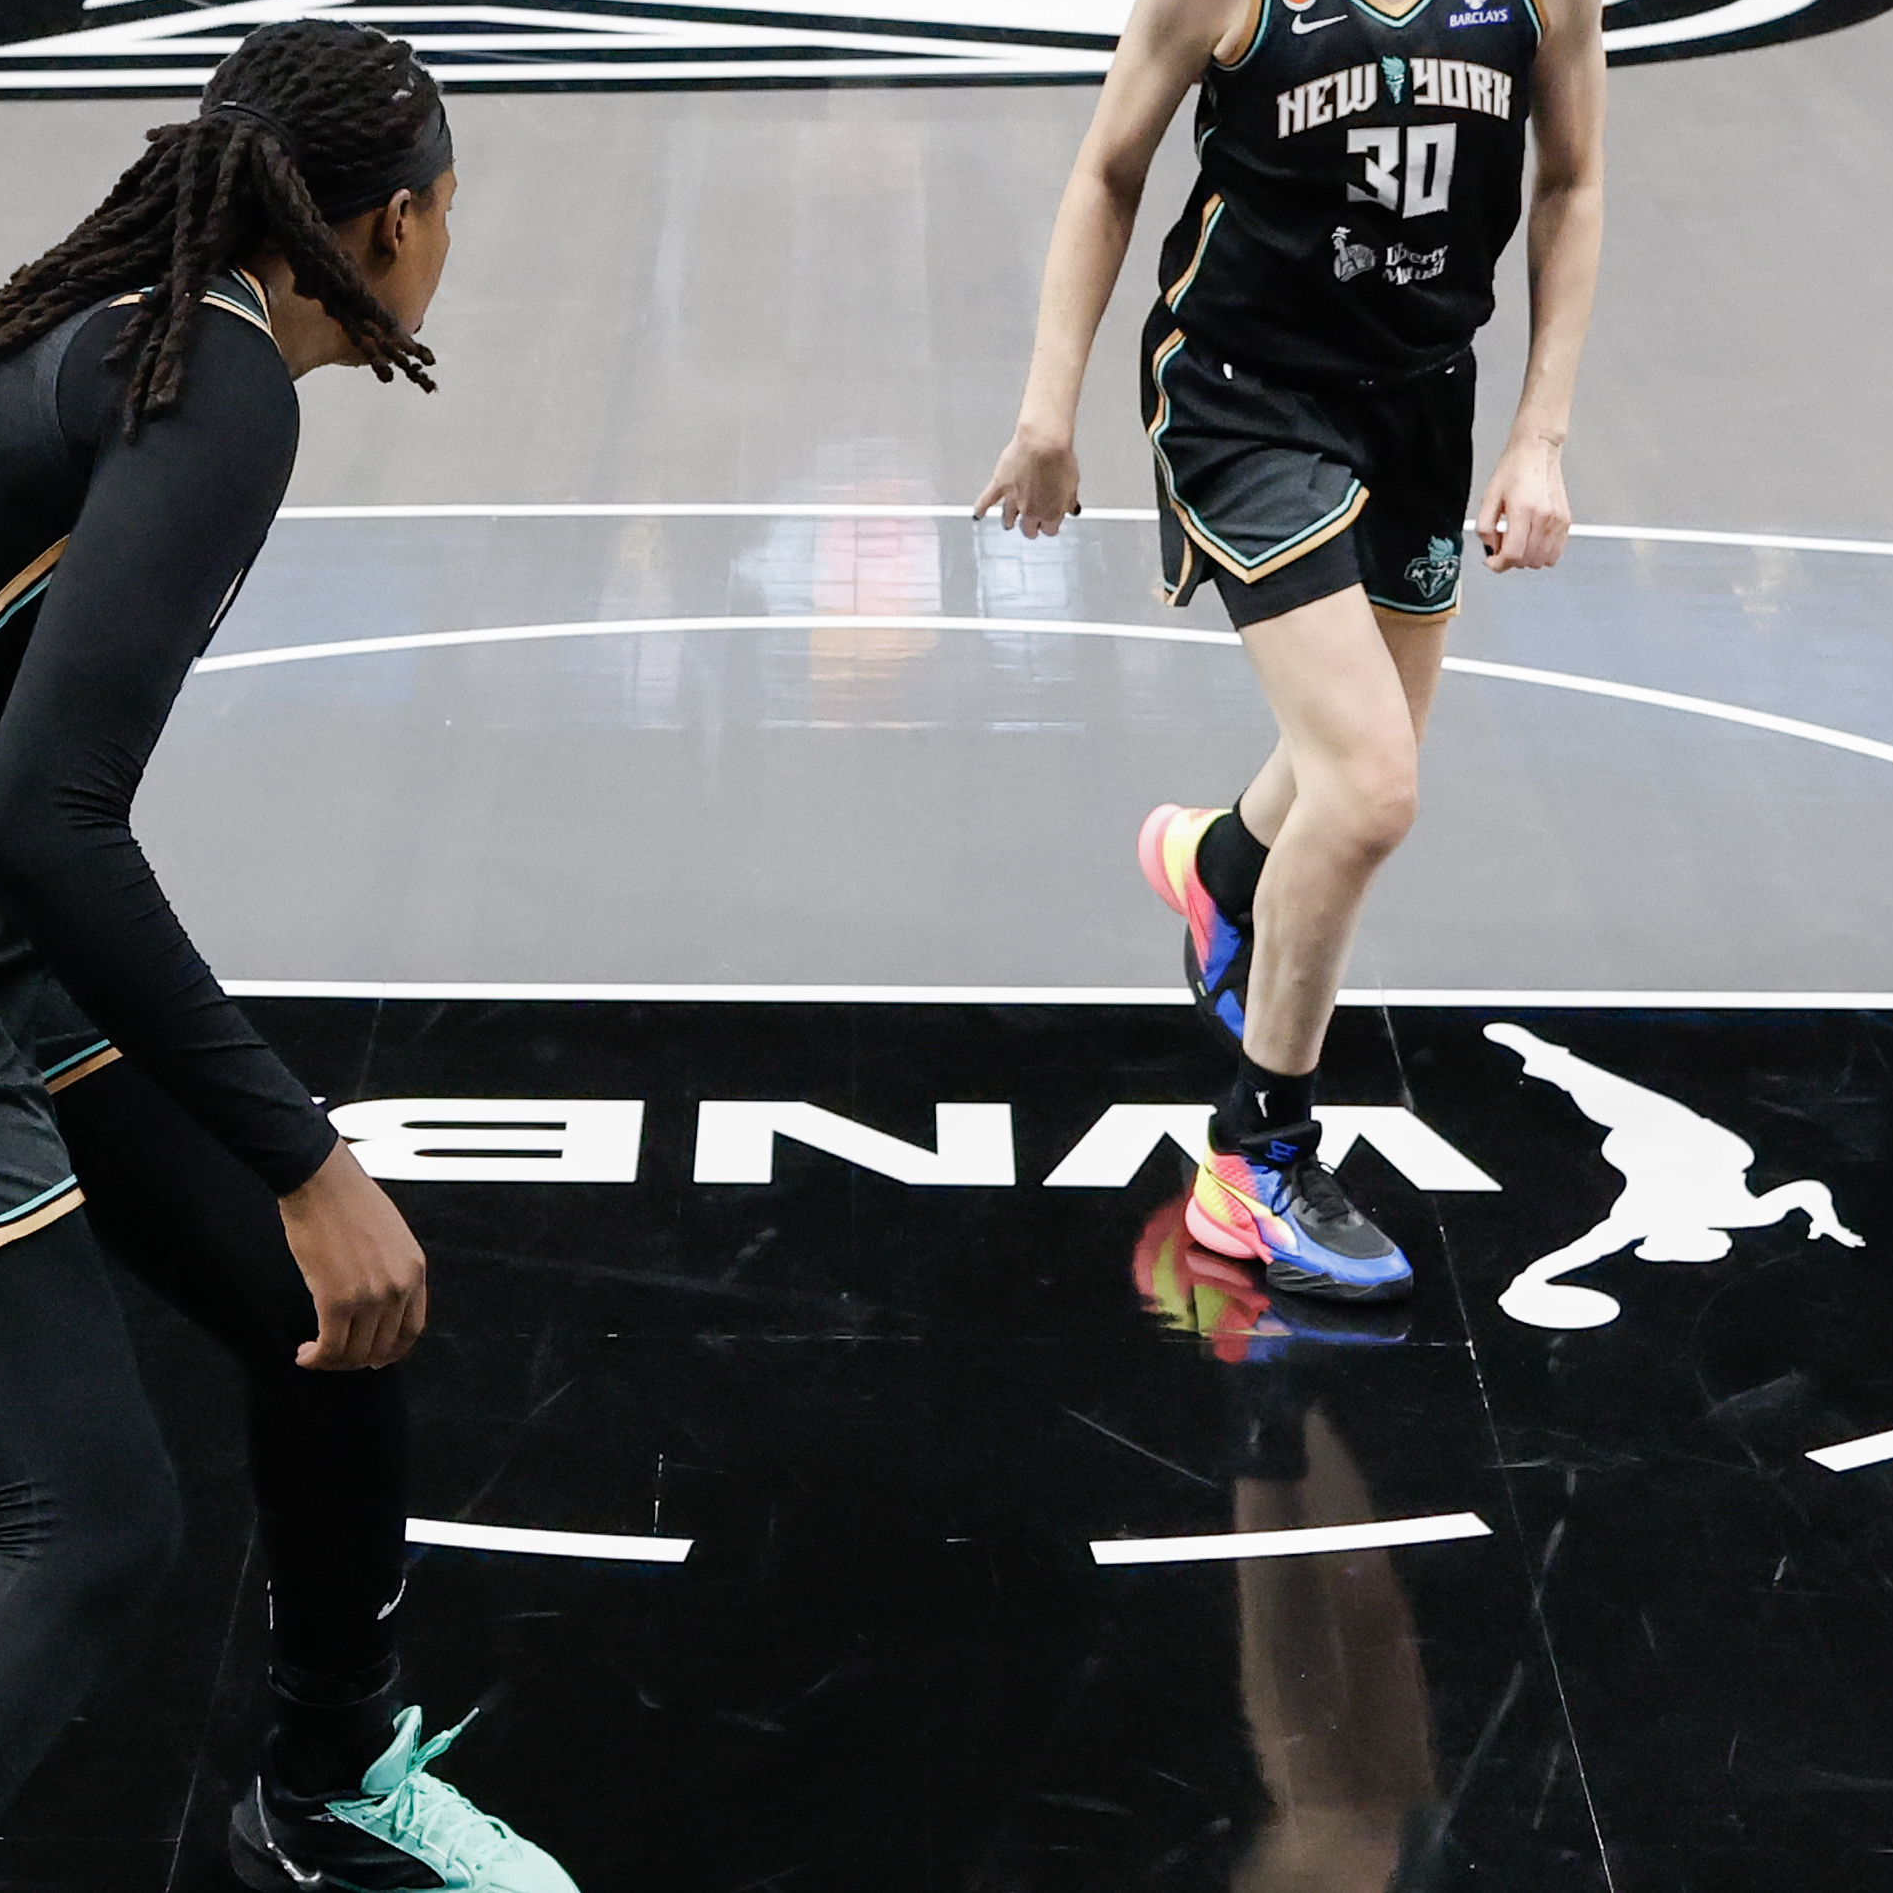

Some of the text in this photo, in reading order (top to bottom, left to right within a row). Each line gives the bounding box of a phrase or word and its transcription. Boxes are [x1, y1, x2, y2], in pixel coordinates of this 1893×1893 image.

[1449, 9, 1508, 27] BARCLAYS
[1276, 57, 1512, 139] NEW YORK
[1346, 122, 1457, 219] 30
